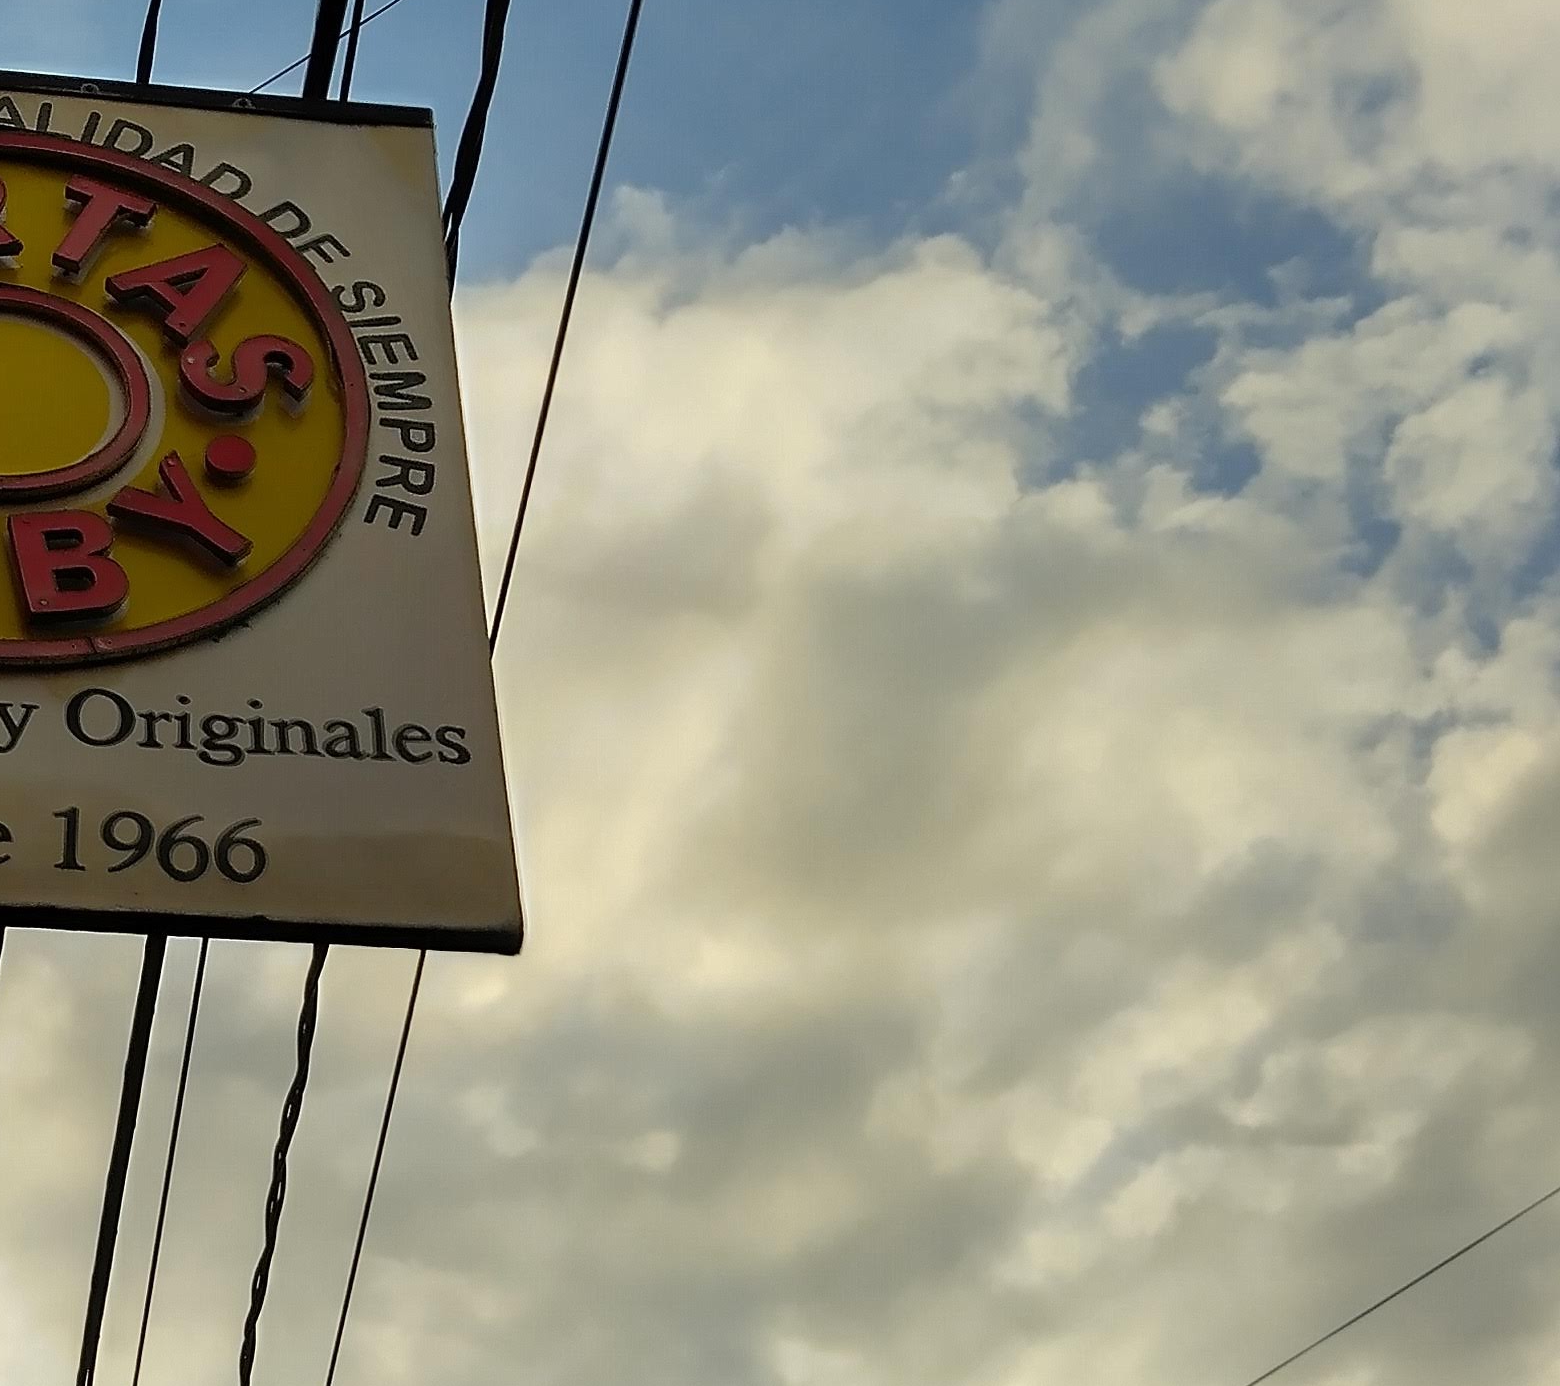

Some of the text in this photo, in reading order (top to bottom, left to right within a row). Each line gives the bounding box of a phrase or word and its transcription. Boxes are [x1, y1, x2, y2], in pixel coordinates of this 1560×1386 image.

[256, 201, 351, 271] DE
[336, 280, 437, 537] SIEMPRE
[64, 687, 473, 767] Originales
[52, 806, 269, 883] 1966
